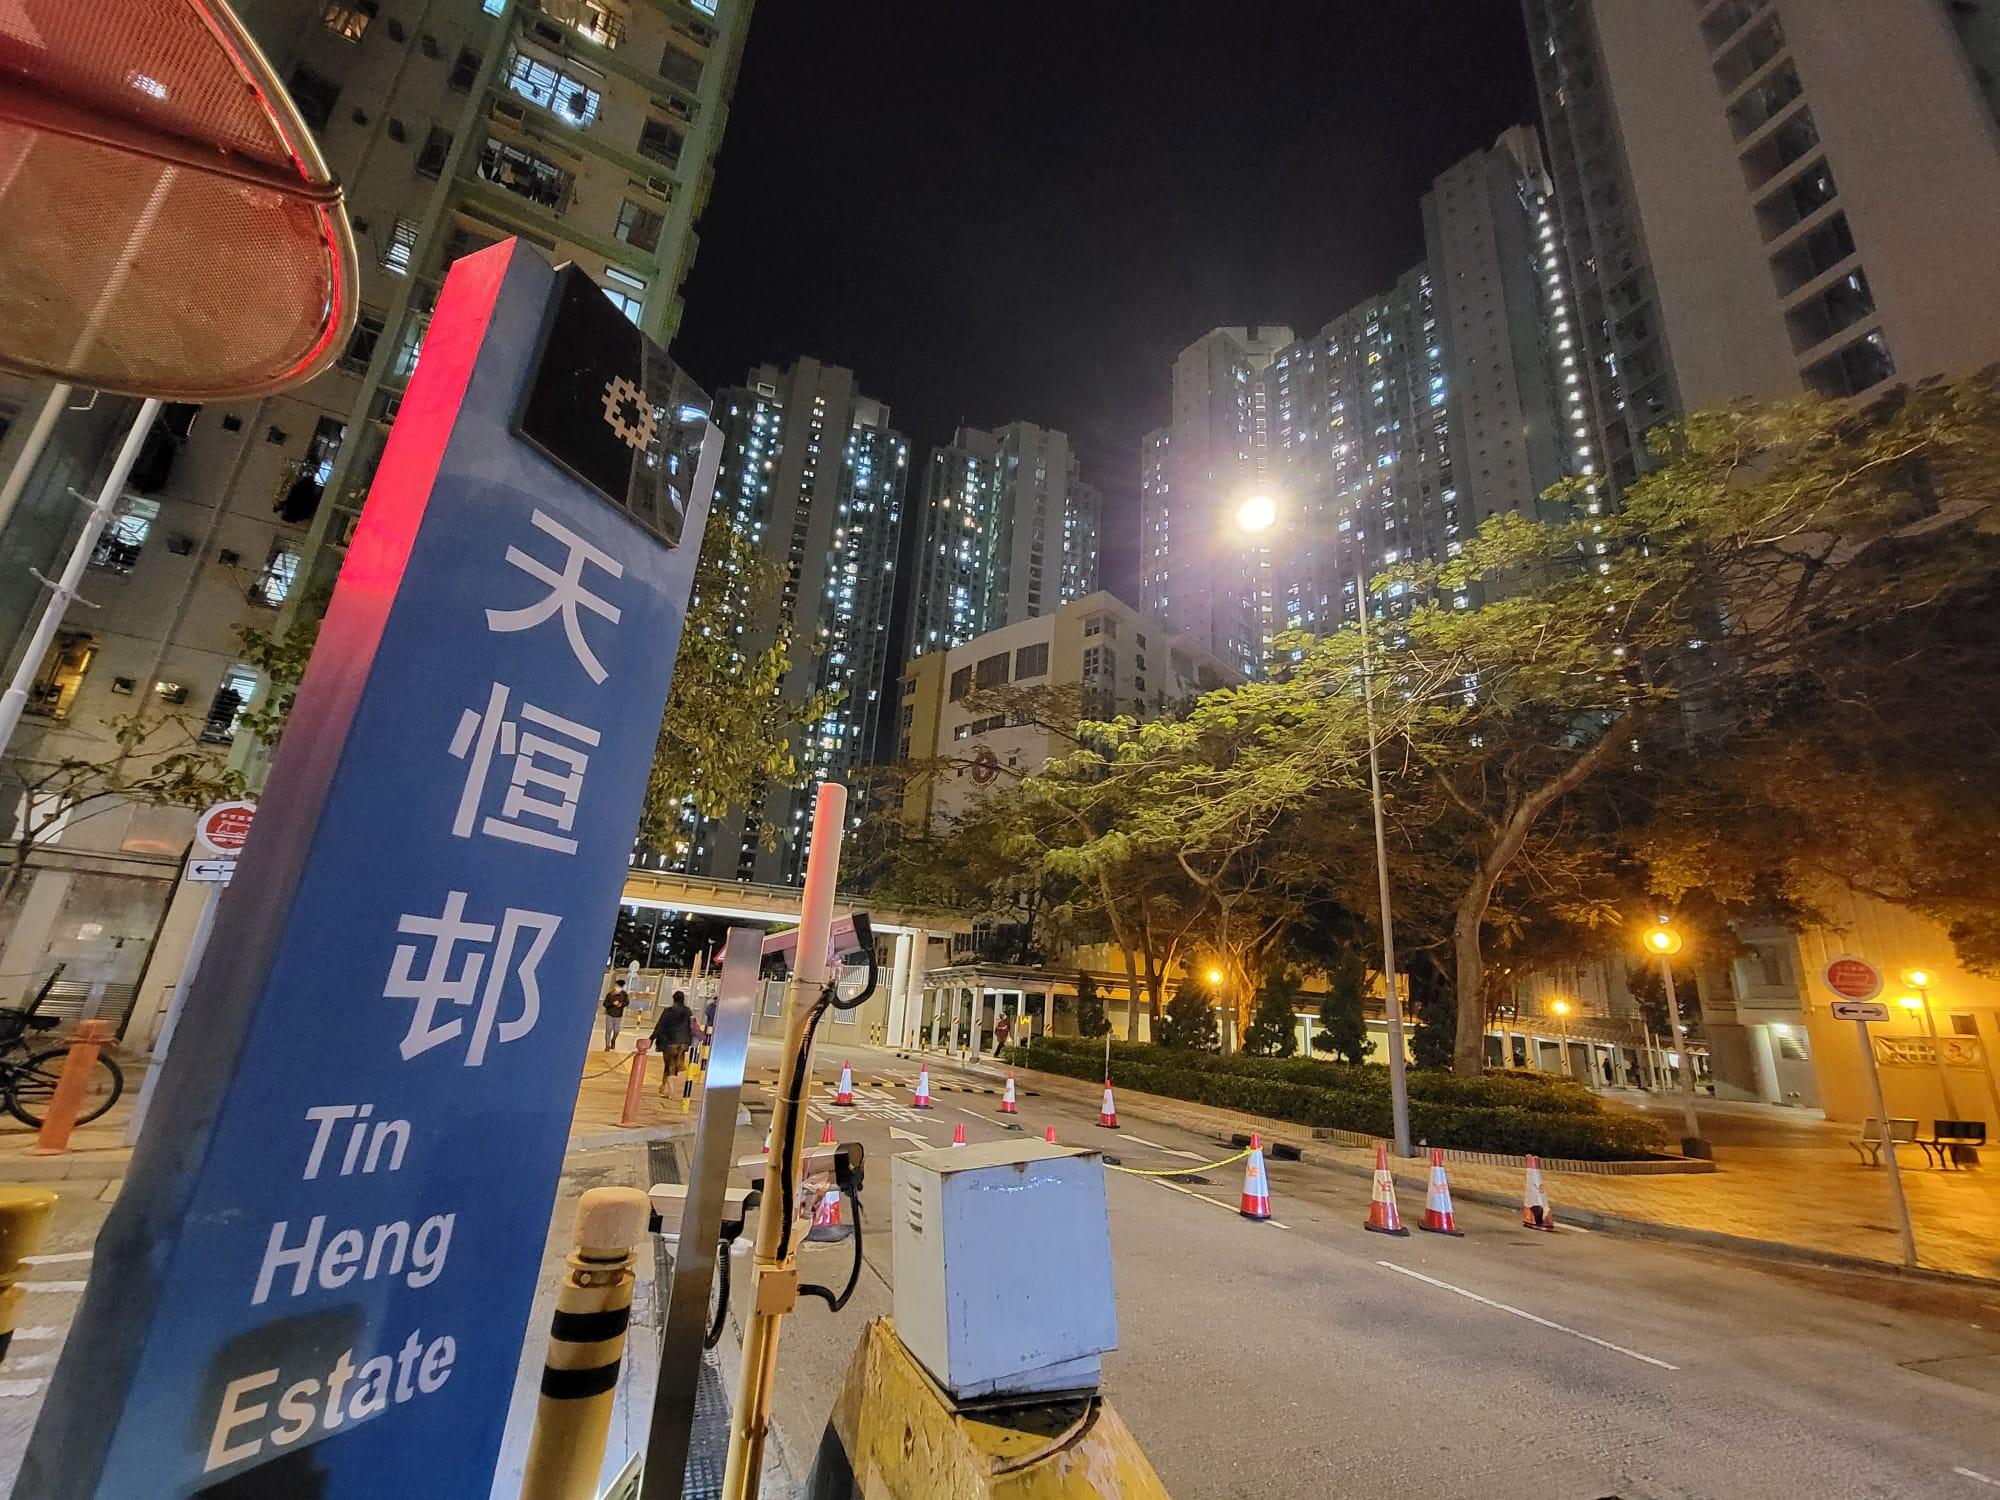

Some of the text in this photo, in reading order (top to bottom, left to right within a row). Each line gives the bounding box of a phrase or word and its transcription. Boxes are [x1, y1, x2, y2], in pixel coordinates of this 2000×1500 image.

[383, 507, 624, 1067] 天恒邨
[303, 1103, 411, 1181] Tin
[250, 1213, 457, 1305] Heng
[203, 1328, 457, 1473] Estate
